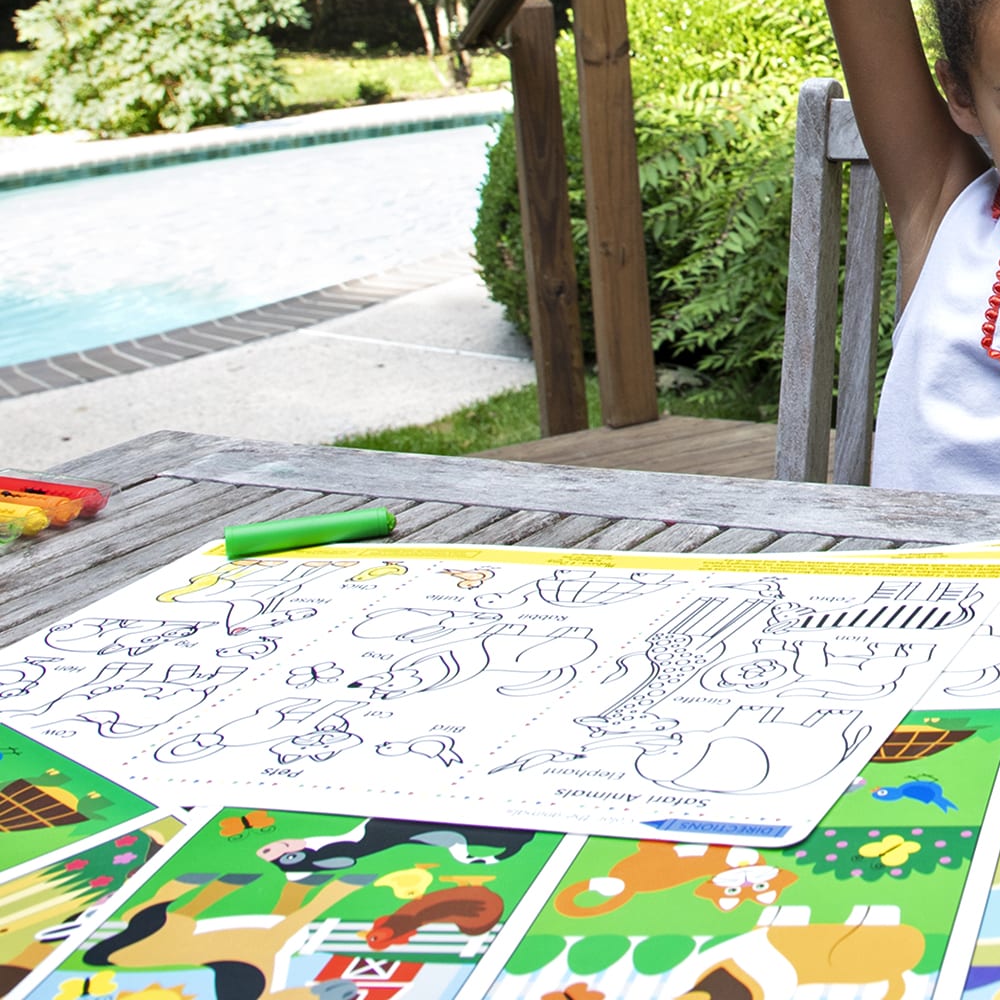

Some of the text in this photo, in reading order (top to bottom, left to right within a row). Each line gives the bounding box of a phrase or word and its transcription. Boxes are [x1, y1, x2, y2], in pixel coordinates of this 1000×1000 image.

[517, 613, 569, 622] Rabbit
[174, 639, 200, 648] Pig
[361, 651, 395, 661] Dog
[673, 696, 732, 706] Giraffe
[363, 710, 394, 718] Cat
[428, 723, 467, 733] Bird
[41, 729, 77, 738] Cow
[260, 766, 304, 778] Pets
[542, 767, 626, 780] Elephant
[554, 788, 711, 808] Safari Animals
[680, 820, 774, 836] DIRECTIONS
